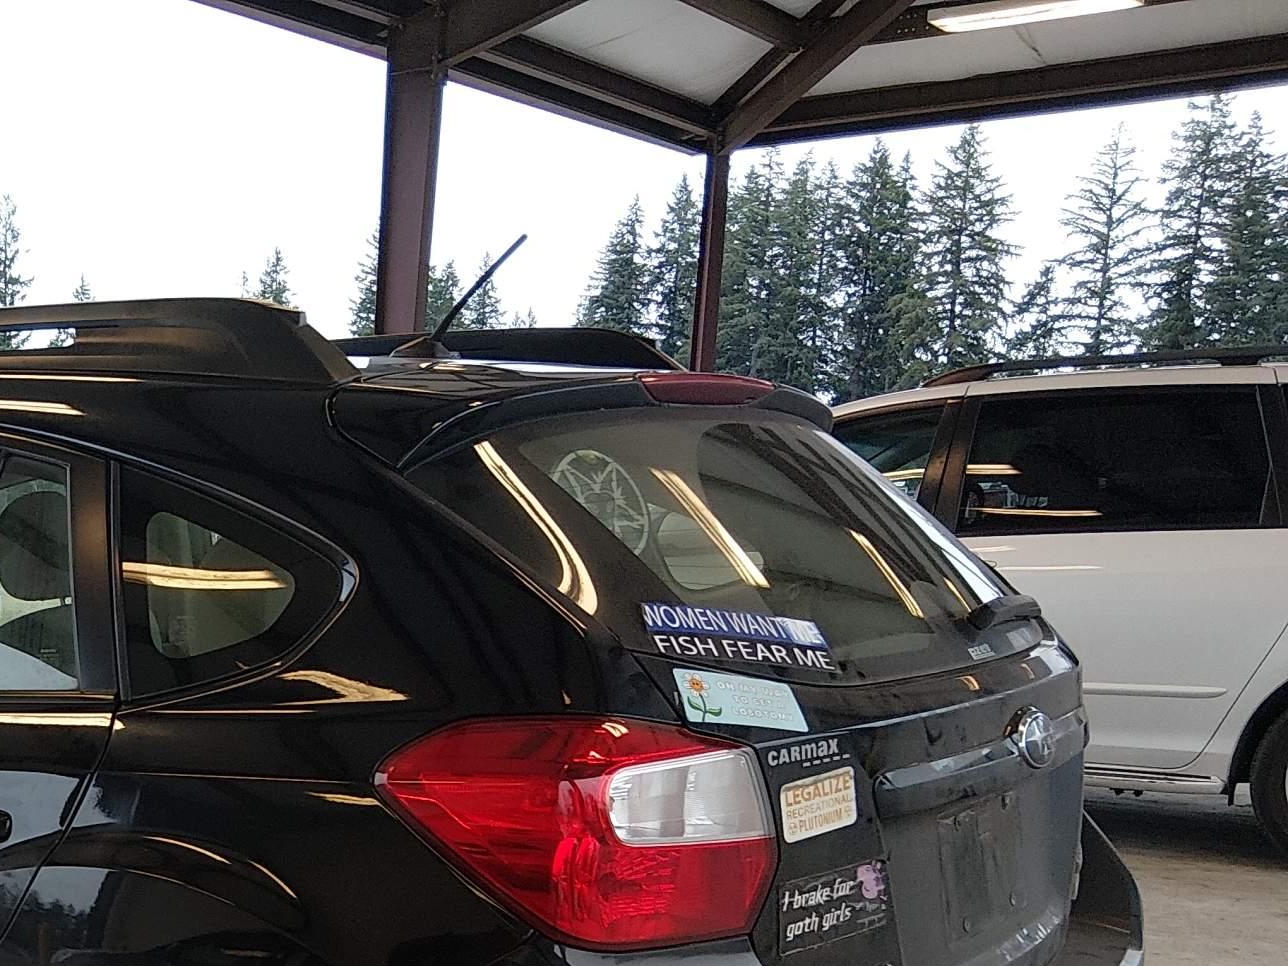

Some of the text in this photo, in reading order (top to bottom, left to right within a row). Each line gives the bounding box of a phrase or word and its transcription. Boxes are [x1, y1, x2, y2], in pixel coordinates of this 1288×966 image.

[643, 604, 728, 633] WOMEN
[727, 611, 788, 639] WANT
[653, 635, 835, 671] FISH FEAR ME
[785, 773, 851, 807] LEGALIZE
[786, 793, 852, 819] RECREATIONAL
[798, 807, 842, 832] PLUTONIUM
[792, 884, 831, 909] brake
[831, 878, 855, 899] for
[785, 902, 852, 942] goth girls
